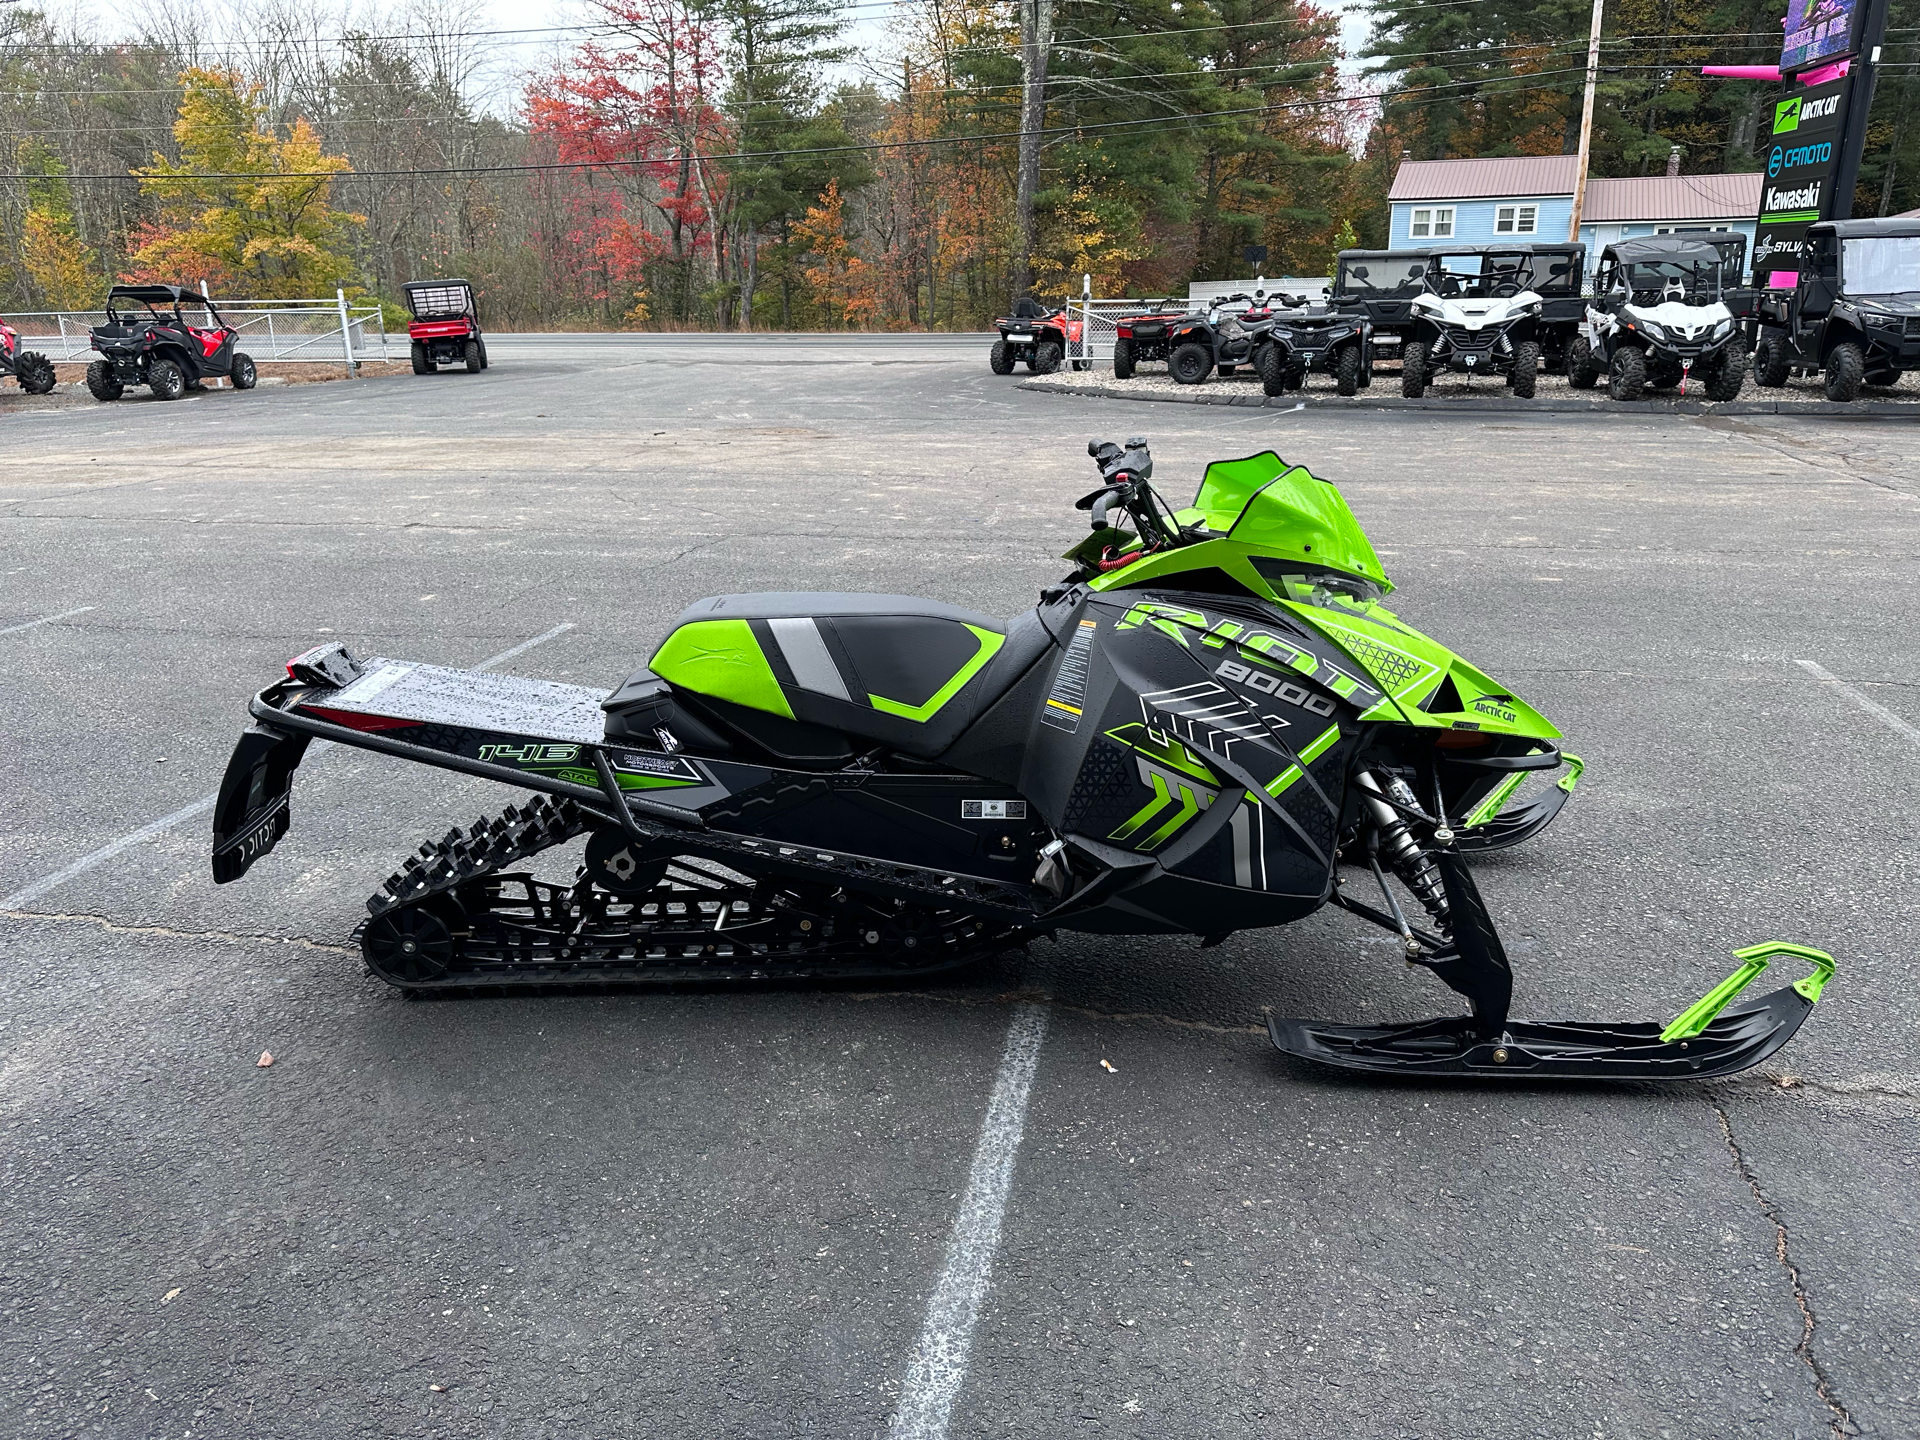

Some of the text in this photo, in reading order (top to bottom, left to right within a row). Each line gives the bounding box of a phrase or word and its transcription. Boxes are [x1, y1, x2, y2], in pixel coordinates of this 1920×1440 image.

[1800, 94, 1841, 121] ARCTIC CAT
[1784, 142, 1832, 168] CFMOTO
[1765, 181, 1821, 211] Kawasaki
[1113, 601, 1381, 699] RIOT
[1214, 659, 1338, 718] 8000
[1474, 702, 1517, 723] ARCTIC CAT
[478, 744, 583, 763] 146
